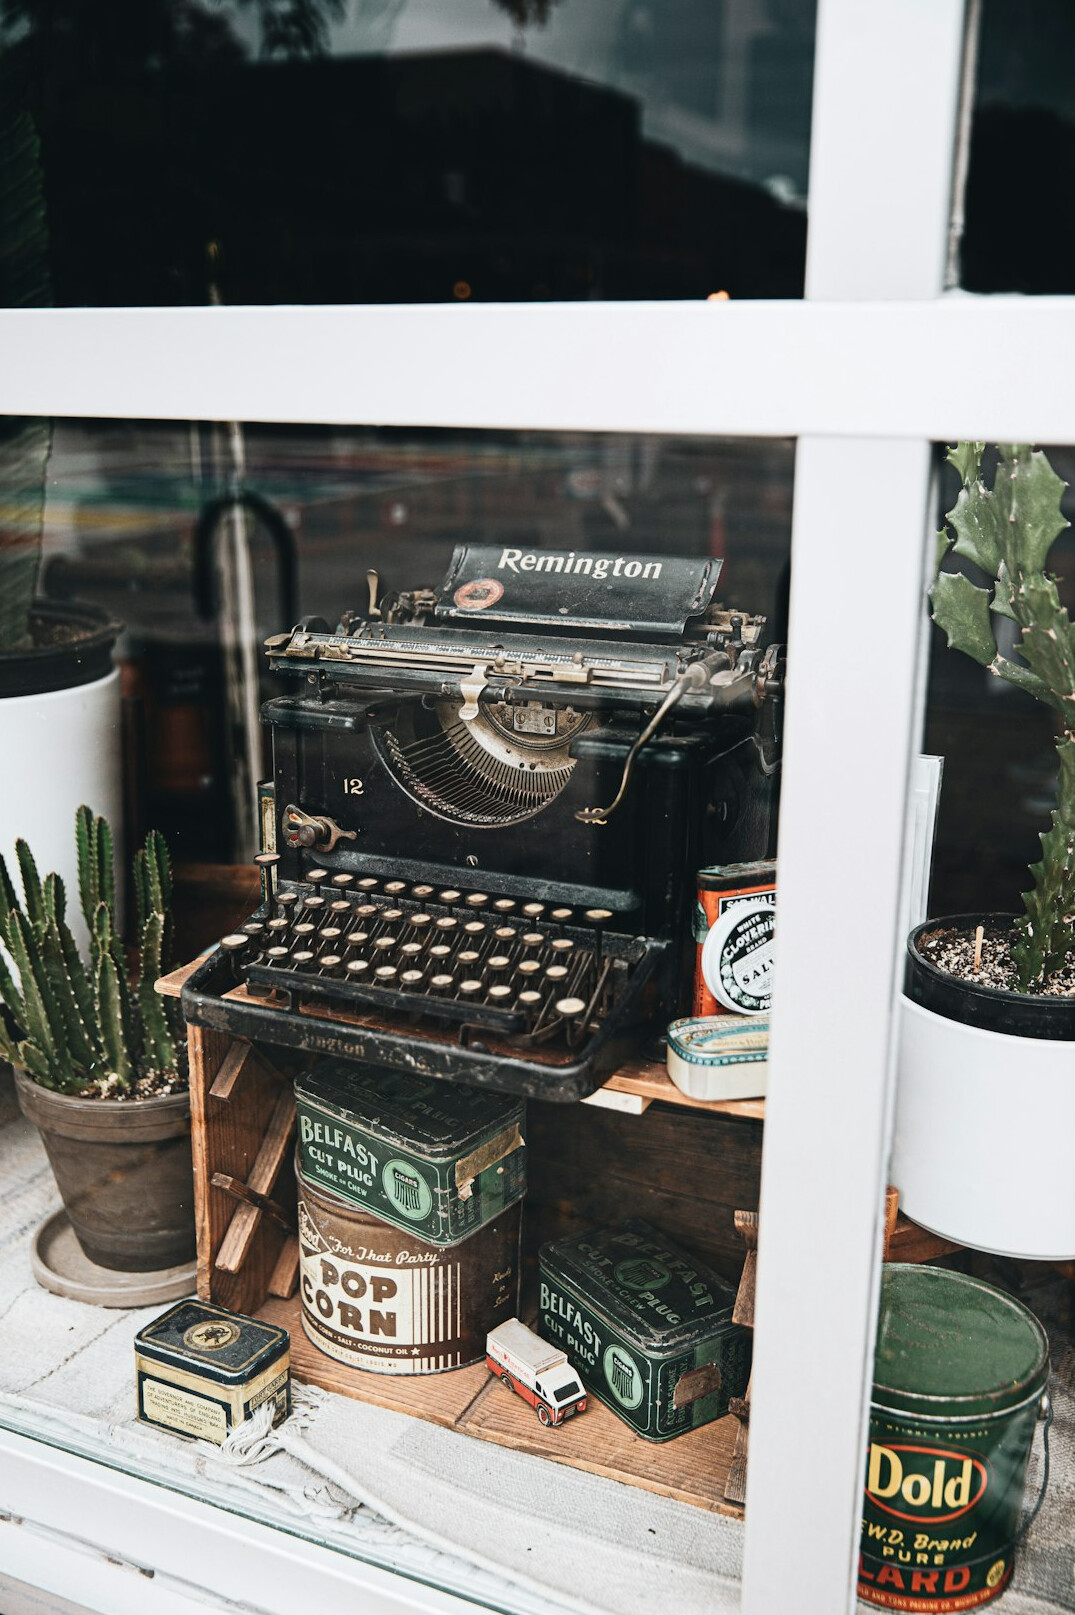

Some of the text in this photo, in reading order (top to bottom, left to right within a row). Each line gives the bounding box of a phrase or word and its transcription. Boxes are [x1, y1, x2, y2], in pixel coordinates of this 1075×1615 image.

[497, 549, 663, 580] Remington
[343, 778, 364, 795] 12
[737, 914, 761, 933] WHITE
[746, 937, 768, 953] BRAND
[412, 1101, 461, 1128] PLUG
[301, 1115, 379, 1177] BELFAST
[308, 1146, 373, 1187] CUT PLUG
[315, 1164, 339, 1183] SMOKE
[347, 1181, 368, 1197] CHEW
[394, 1171, 418, 1188] CIGARS
[356, 1246, 392, 1263] That
[612, 1232, 714, 1307] BELFAST
[320, 1258, 398, 1303] POP
[577, 1243, 682, 1325] CUT PLUG
[581, 1260, 614, 1285] SMOKE
[619, 1290, 647, 1311] CHEW
[302, 1274, 397, 1338] CORN
[540, 1282, 602, 1357] BELFAST
[337, 1336, 353, 1346] SALT
[357, 1342, 394, 1354] COCONUT
[544, 1314, 564, 1338] CUT
[567, 1333, 596, 1366] PLUG
[868, 1442, 973, 1508] Dold
[883, 1547, 945, 1565] PURE
[913, 1531, 977, 1551] Brand
